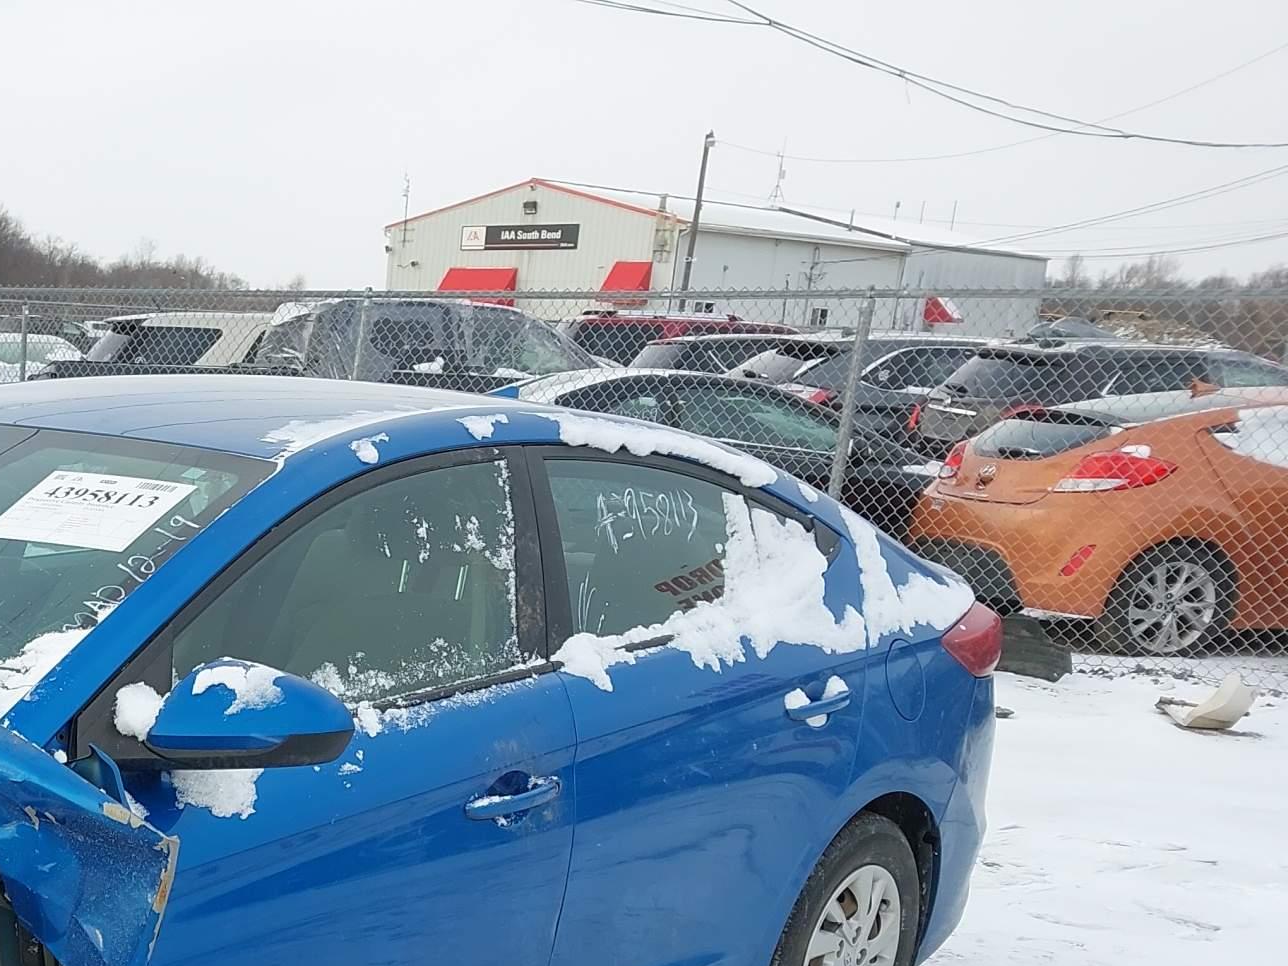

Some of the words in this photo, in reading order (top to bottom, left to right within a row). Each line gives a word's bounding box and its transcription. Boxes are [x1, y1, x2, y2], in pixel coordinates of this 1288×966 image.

[500, 230, 516, 240] IAA
[517, 230, 539, 240] South
[541, 229, 562, 239] Bend
[43, 486, 160, 509] 43958113
